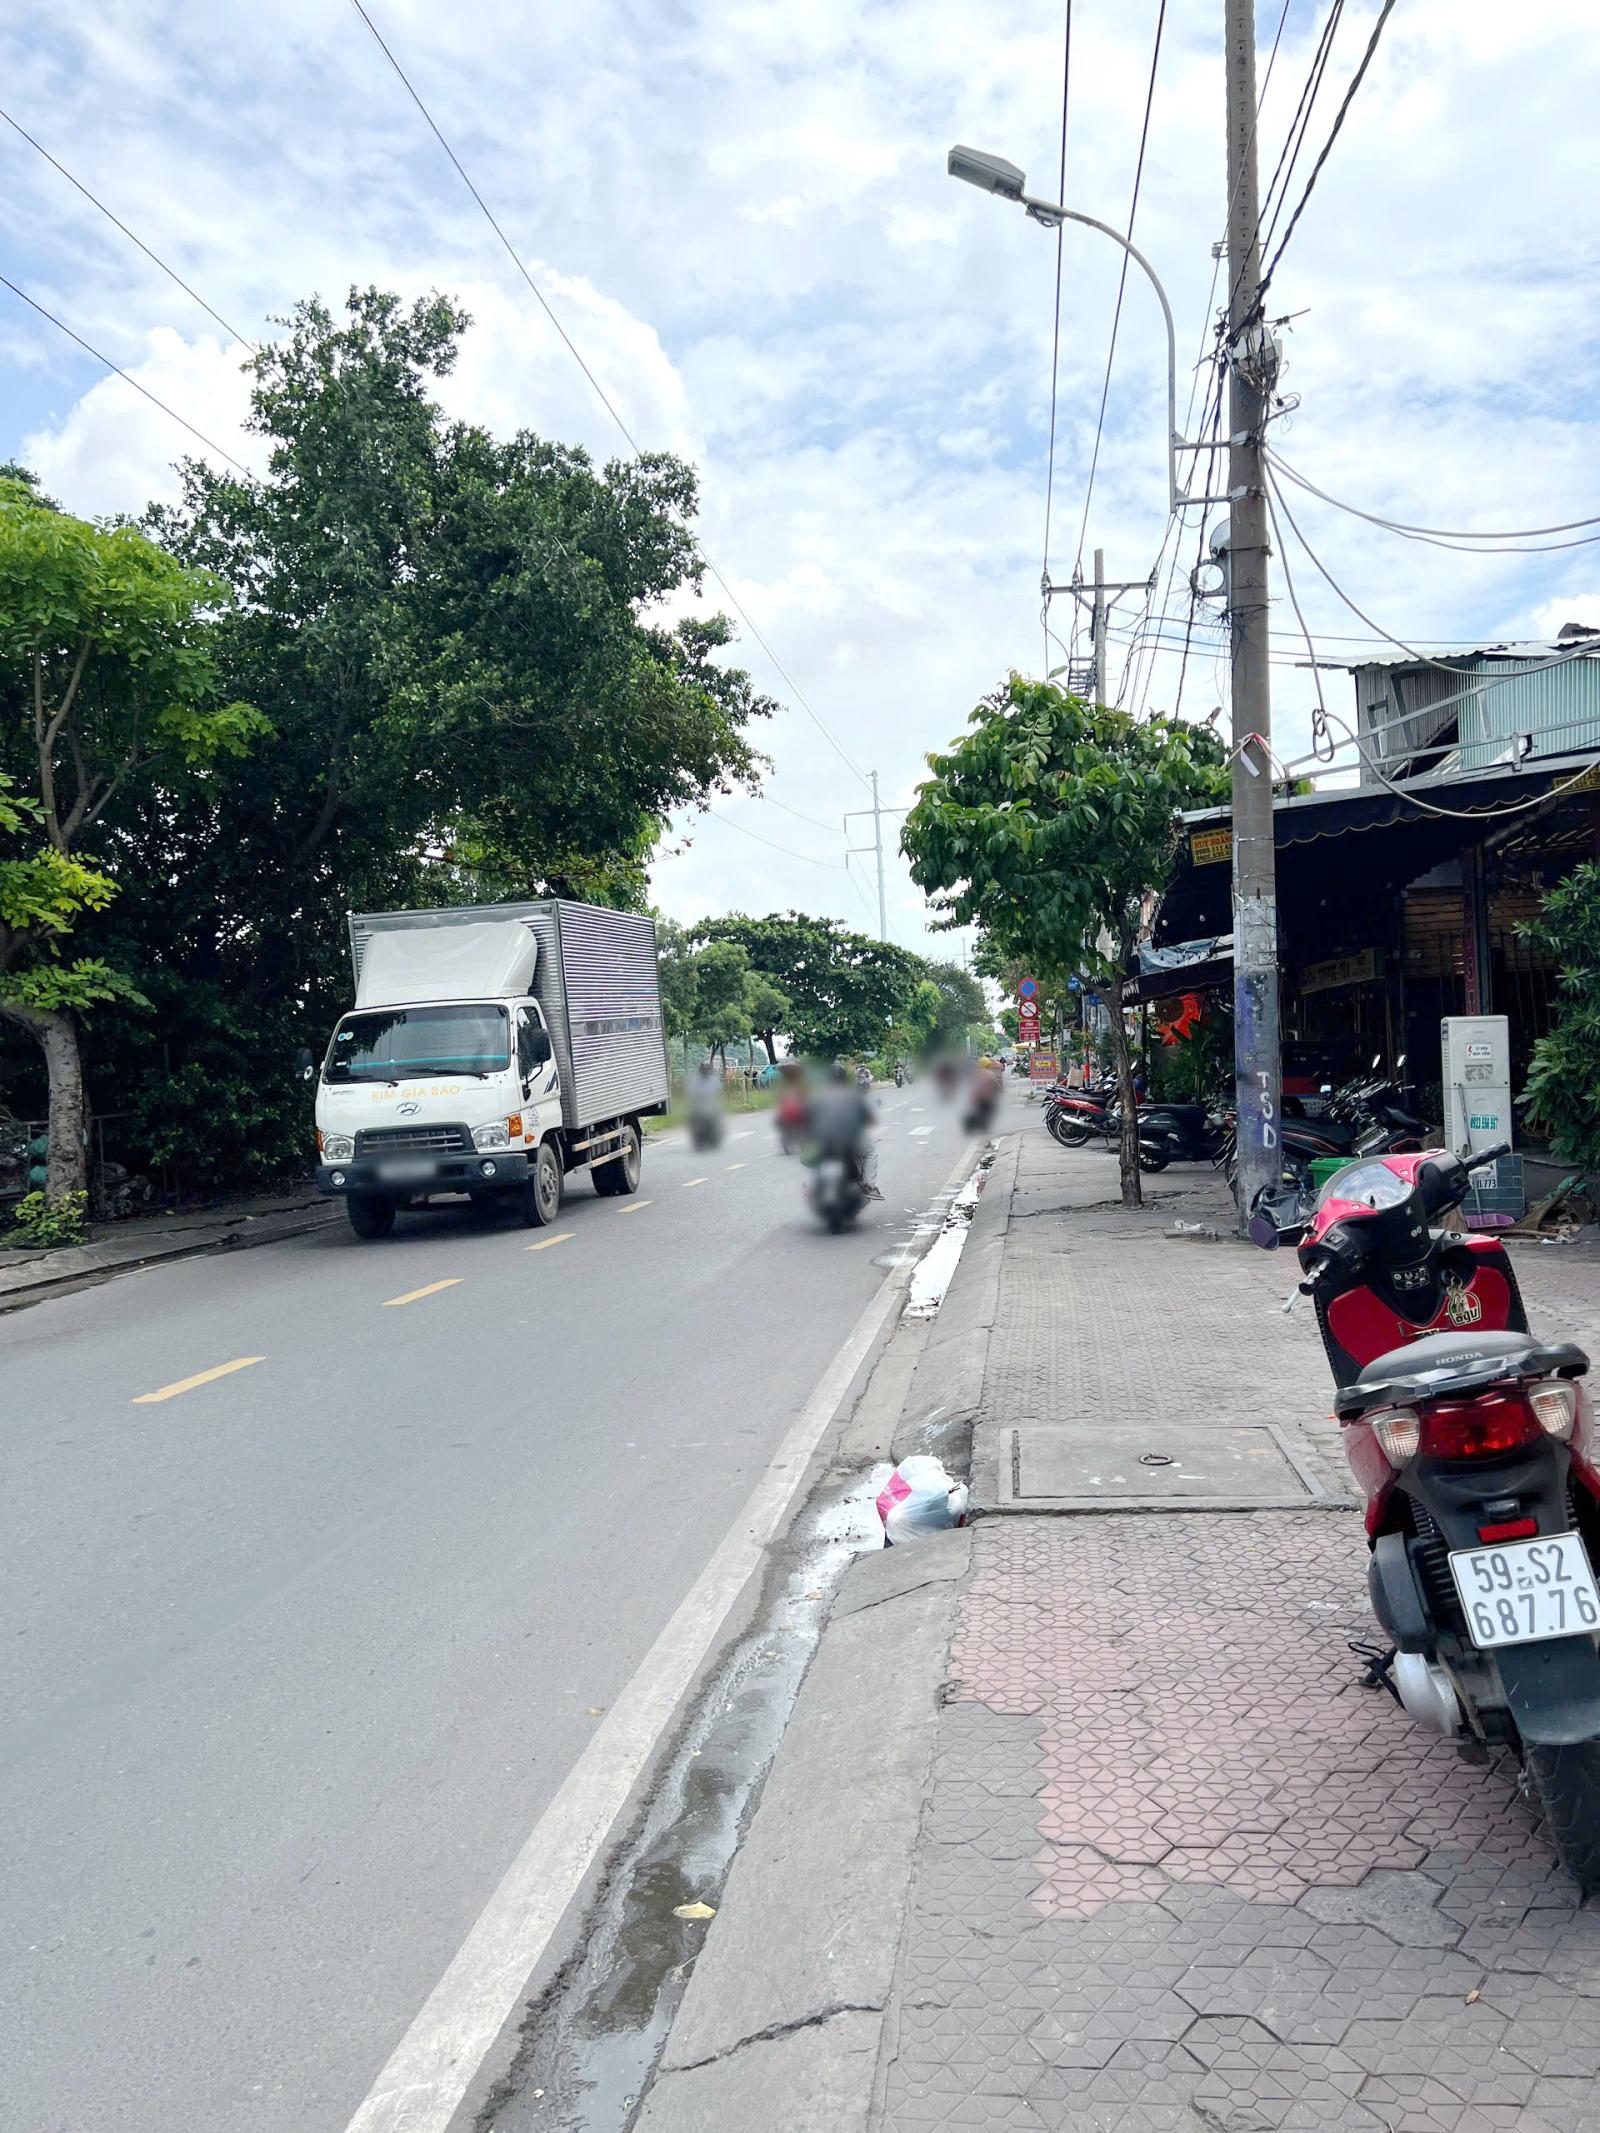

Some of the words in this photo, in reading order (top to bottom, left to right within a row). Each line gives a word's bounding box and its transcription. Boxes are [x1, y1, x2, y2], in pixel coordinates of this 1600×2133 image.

[371, 1089, 396, 1101] KIM
[401, 1086, 426, 1099] GIA
[1435, 1352, 1484, 1365] HONDA
[1472, 1586, 1597, 1640] 687.76
